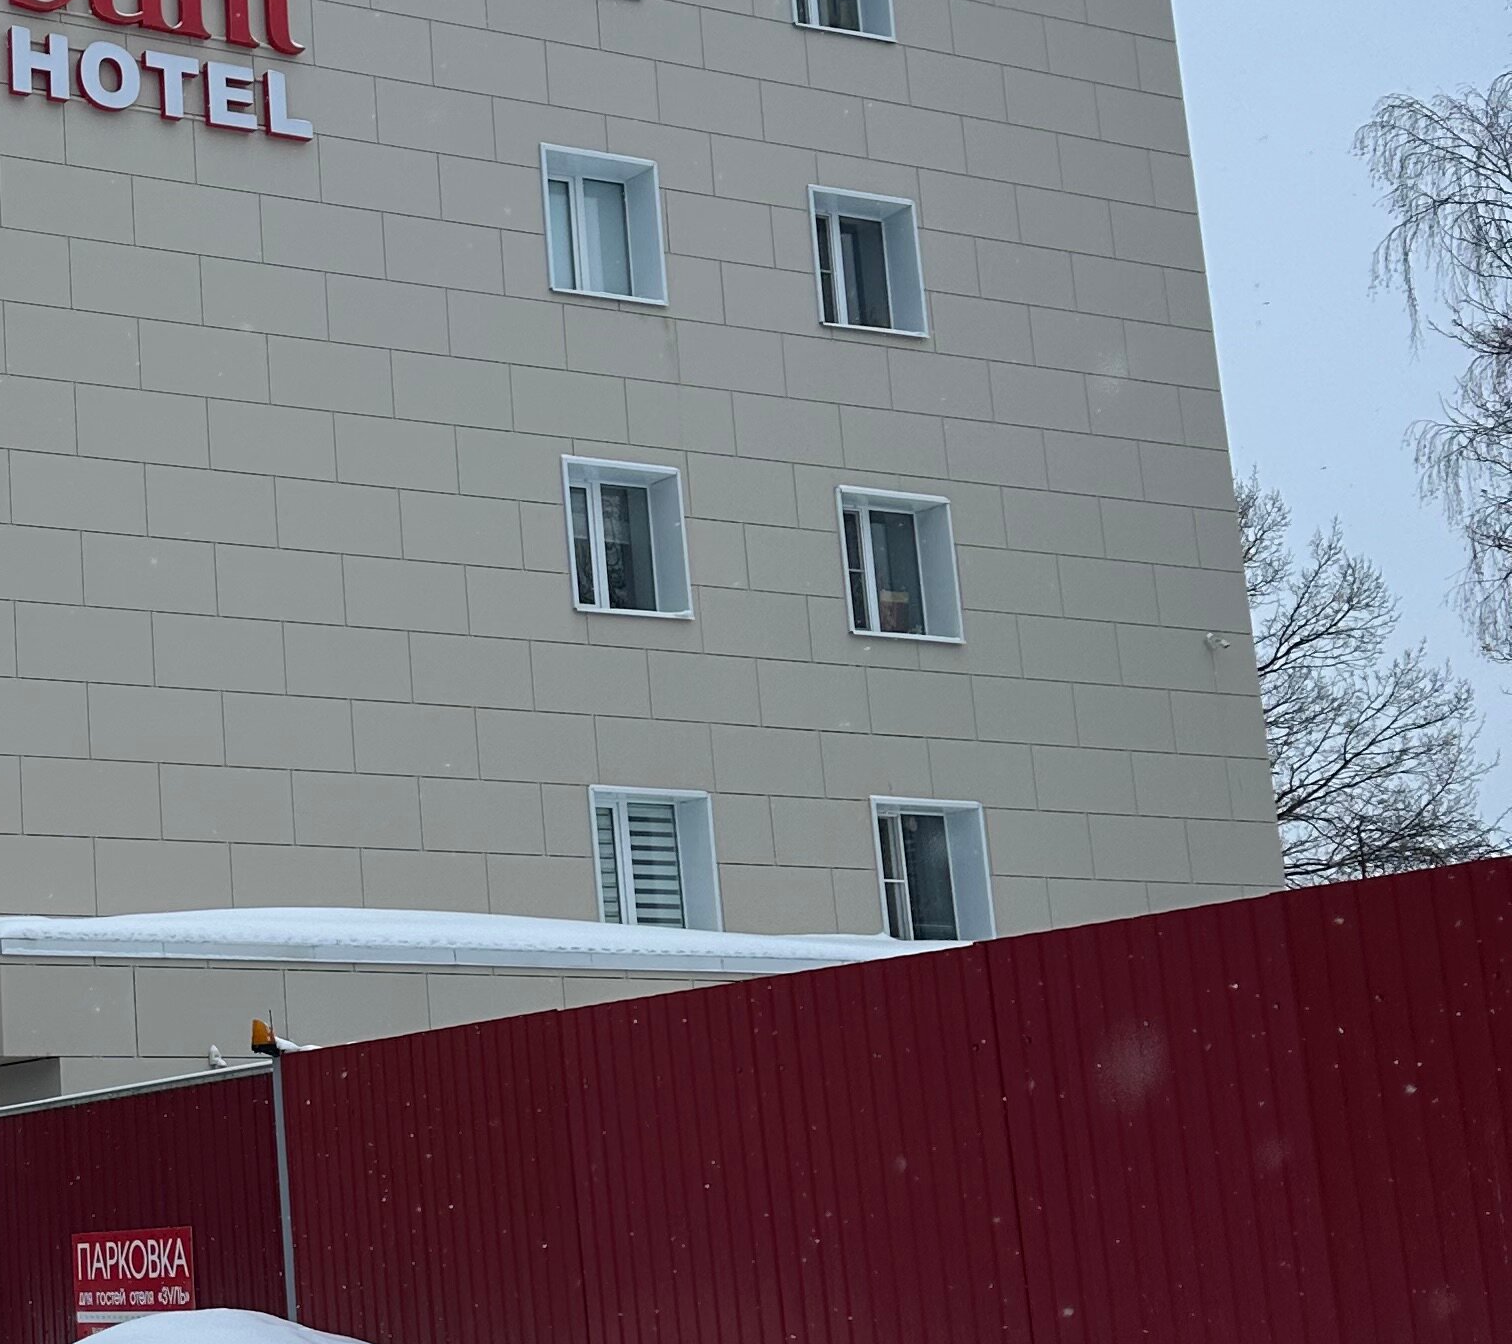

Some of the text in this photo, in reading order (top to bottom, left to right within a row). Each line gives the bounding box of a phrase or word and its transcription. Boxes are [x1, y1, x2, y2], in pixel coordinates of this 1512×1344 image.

[7, 25, 314, 142] HOTEL
[77, 1237, 190, 1281] ПАРКОВКА
[96, 1288, 127, 1306] гостей
[129, 1290, 155, 1306] отеля
